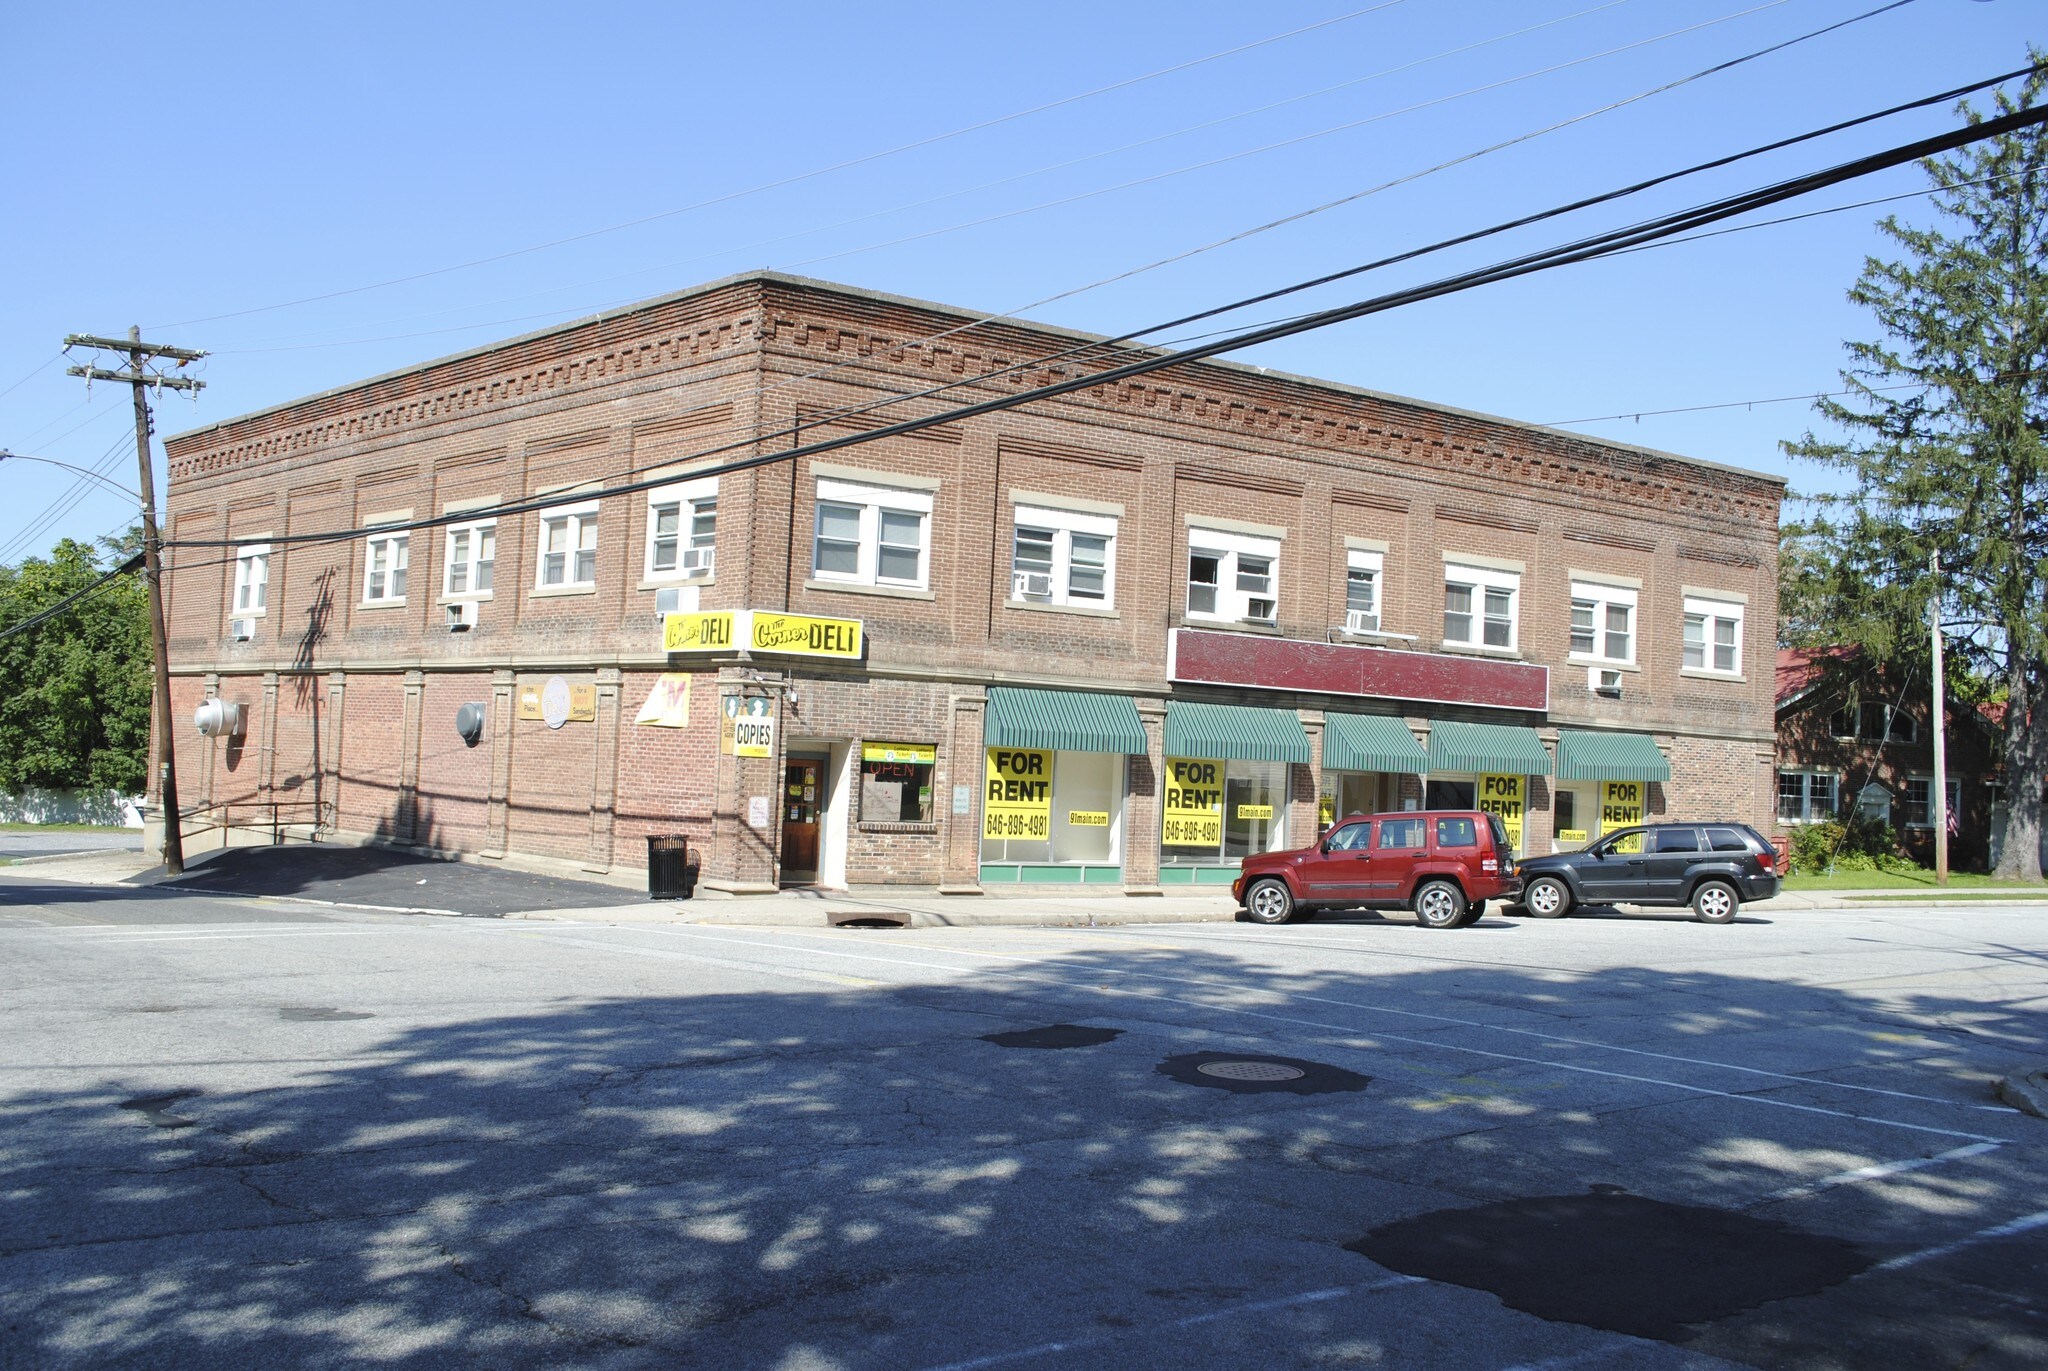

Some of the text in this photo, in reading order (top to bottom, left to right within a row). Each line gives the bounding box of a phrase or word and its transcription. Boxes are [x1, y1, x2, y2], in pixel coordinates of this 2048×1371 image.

[700, 617, 731, 645] DELI
[753, 621, 854, 652] Corner DELI
[737, 723, 771, 746] COPIES
[869, 761, 915, 777] OPEN
[996, 751, 1043, 775] FOR
[1174, 761, 1216, 785] FOR
[988, 779, 1049, 802] RENT
[1485, 776, 1518, 796] FOR
[1608, 783, 1637, 802] FOR
[1167, 788, 1220, 810] RENT
[1480, 799, 1521, 819] RENT
[1069, 811, 1107, 825] 91main.com
[1239, 806, 1272, 818] 91main.com
[1603, 804, 1640, 823] RENT
[987, 813, 1047, 836] 646-896-4981
[1165, 820, 1219, 842] 646-896-4981
